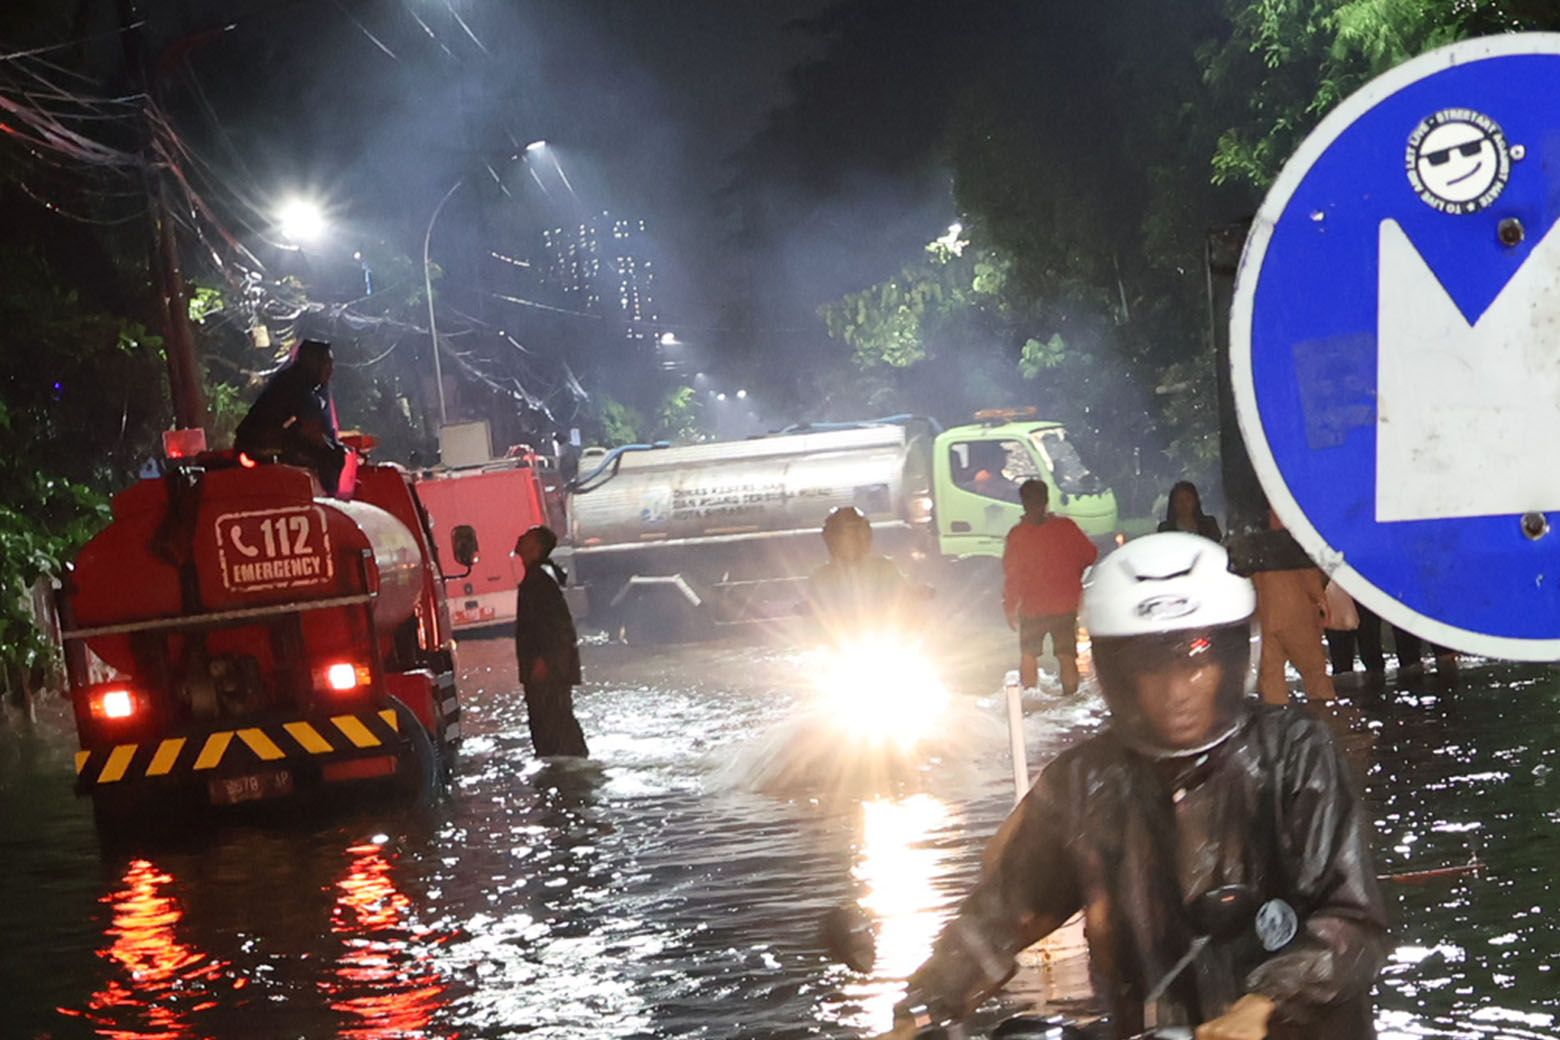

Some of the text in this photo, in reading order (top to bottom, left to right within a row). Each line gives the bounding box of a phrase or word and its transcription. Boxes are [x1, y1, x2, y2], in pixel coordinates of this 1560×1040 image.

[1408, 121, 1430, 146] LIVE
[1405, 146, 1416, 168] LET
[1420, 190, 1444, 211] LIVE
[1445, 203, 1461, 214] TO
[261, 516, 313, 557] 112
[233, 556, 320, 582] EMERGENCY
